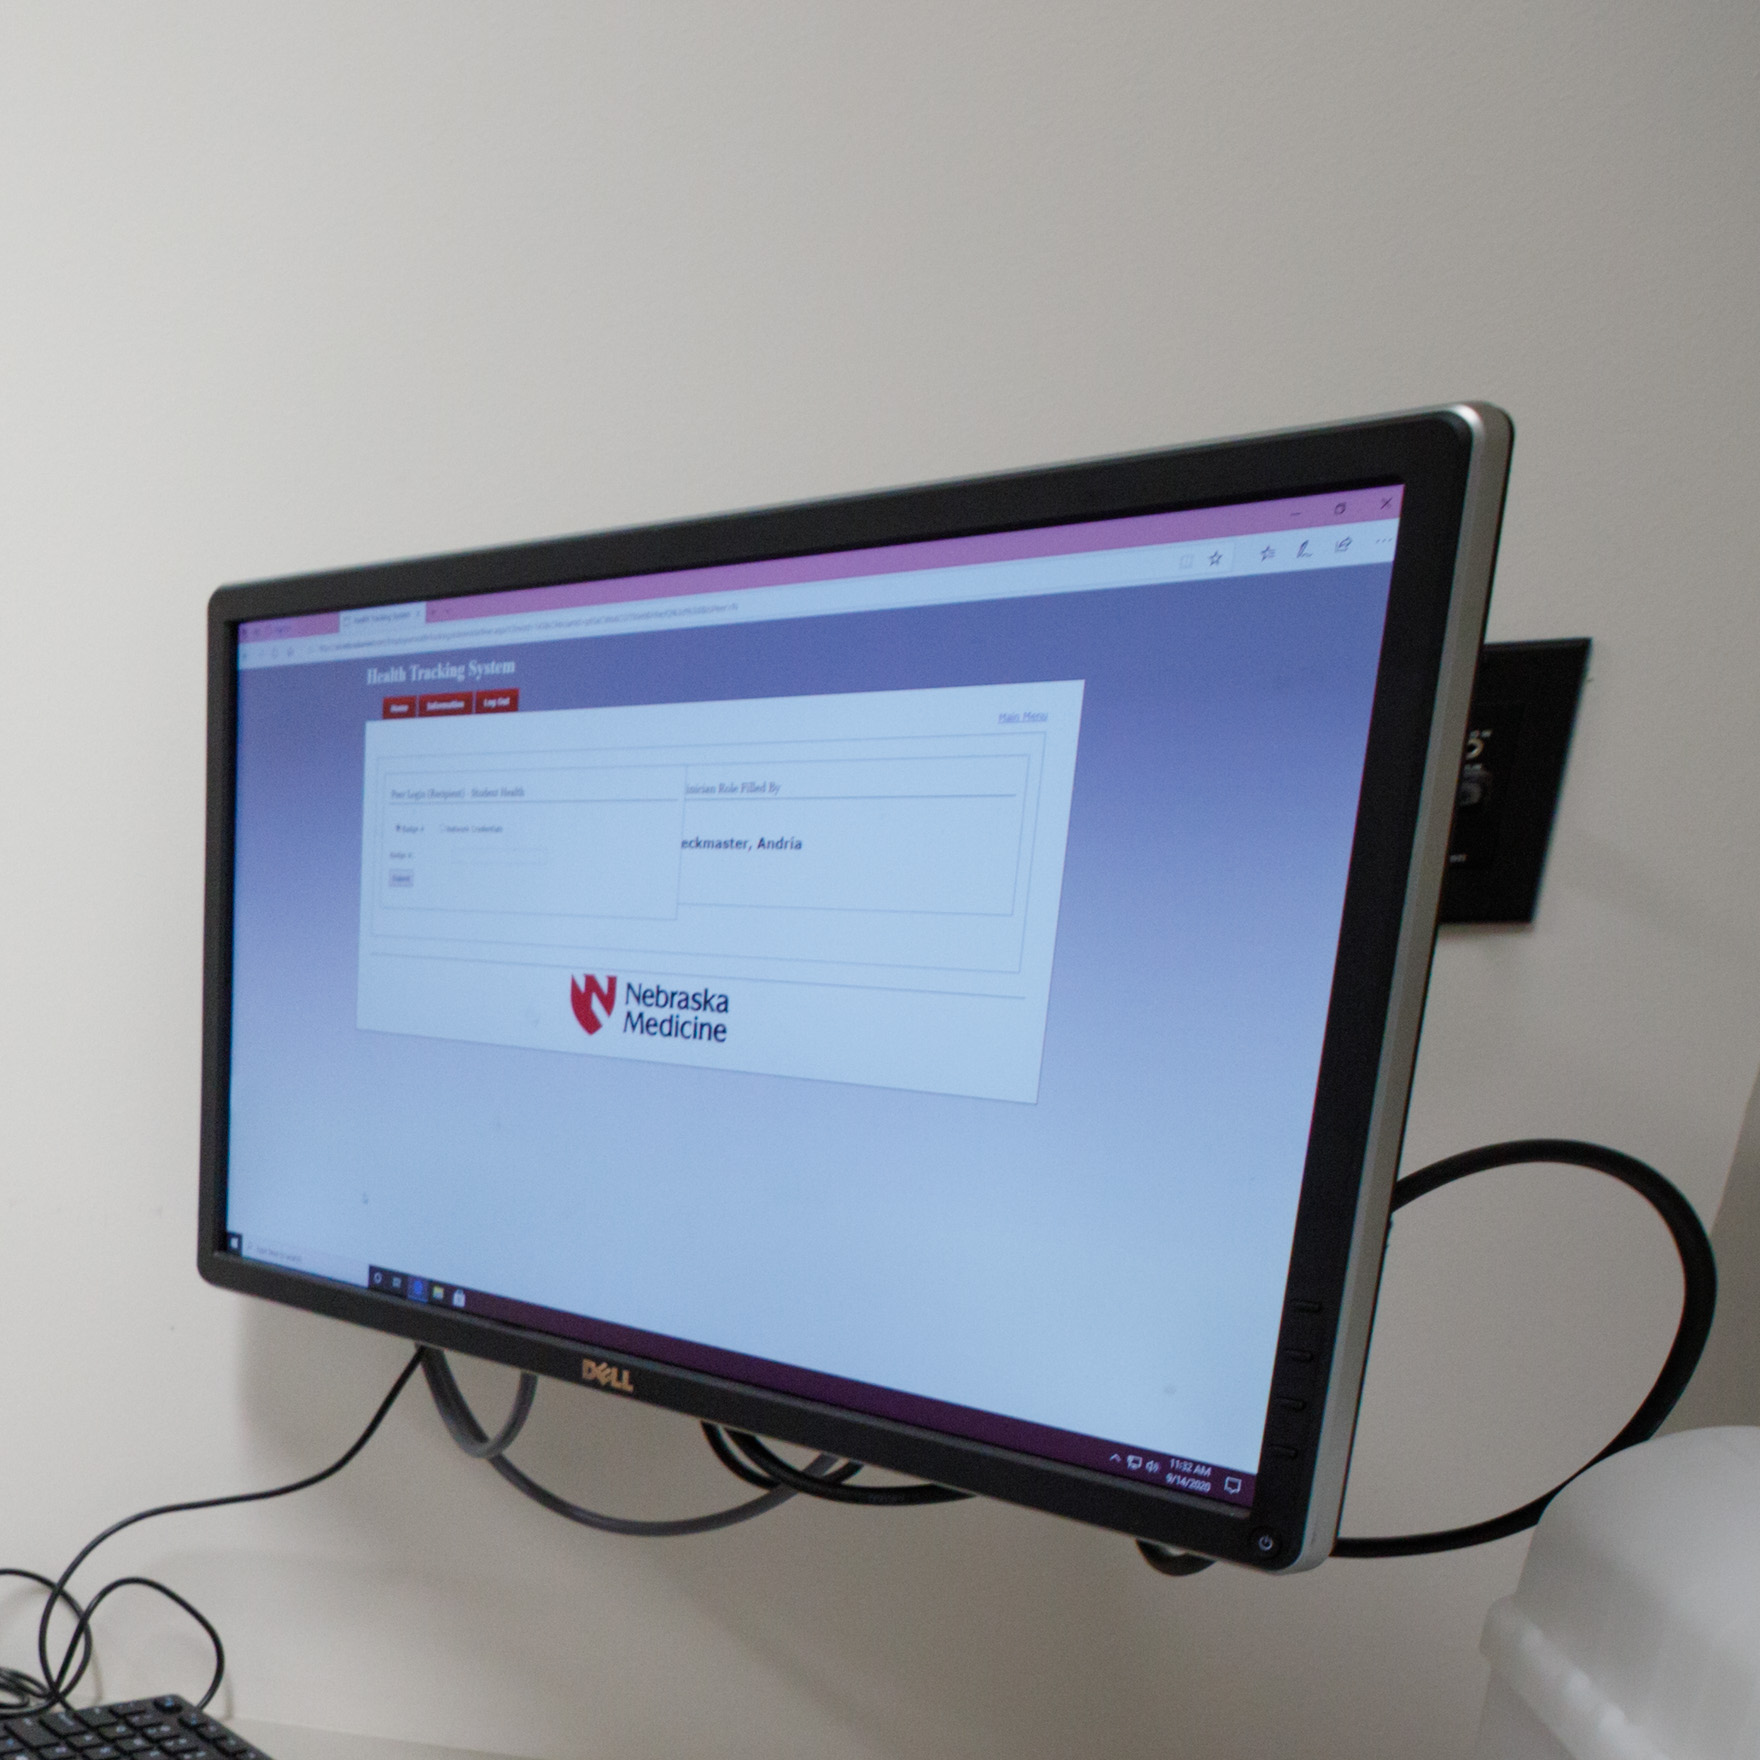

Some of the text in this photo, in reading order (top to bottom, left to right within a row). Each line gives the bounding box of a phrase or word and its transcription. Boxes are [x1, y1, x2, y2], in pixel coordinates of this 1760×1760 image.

[366, 658, 516, 686] Health Tracking System
[718, 782, 738, 794] Role
[740, 781, 767, 794] Filled
[768, 781, 781, 796] By
[681, 836, 803, 854] eckmaster, Andria
[624, 982, 729, 1014] Nebraska
[623, 1011, 728, 1043] Medicine
[582, 1358, 634, 1393] DELL
